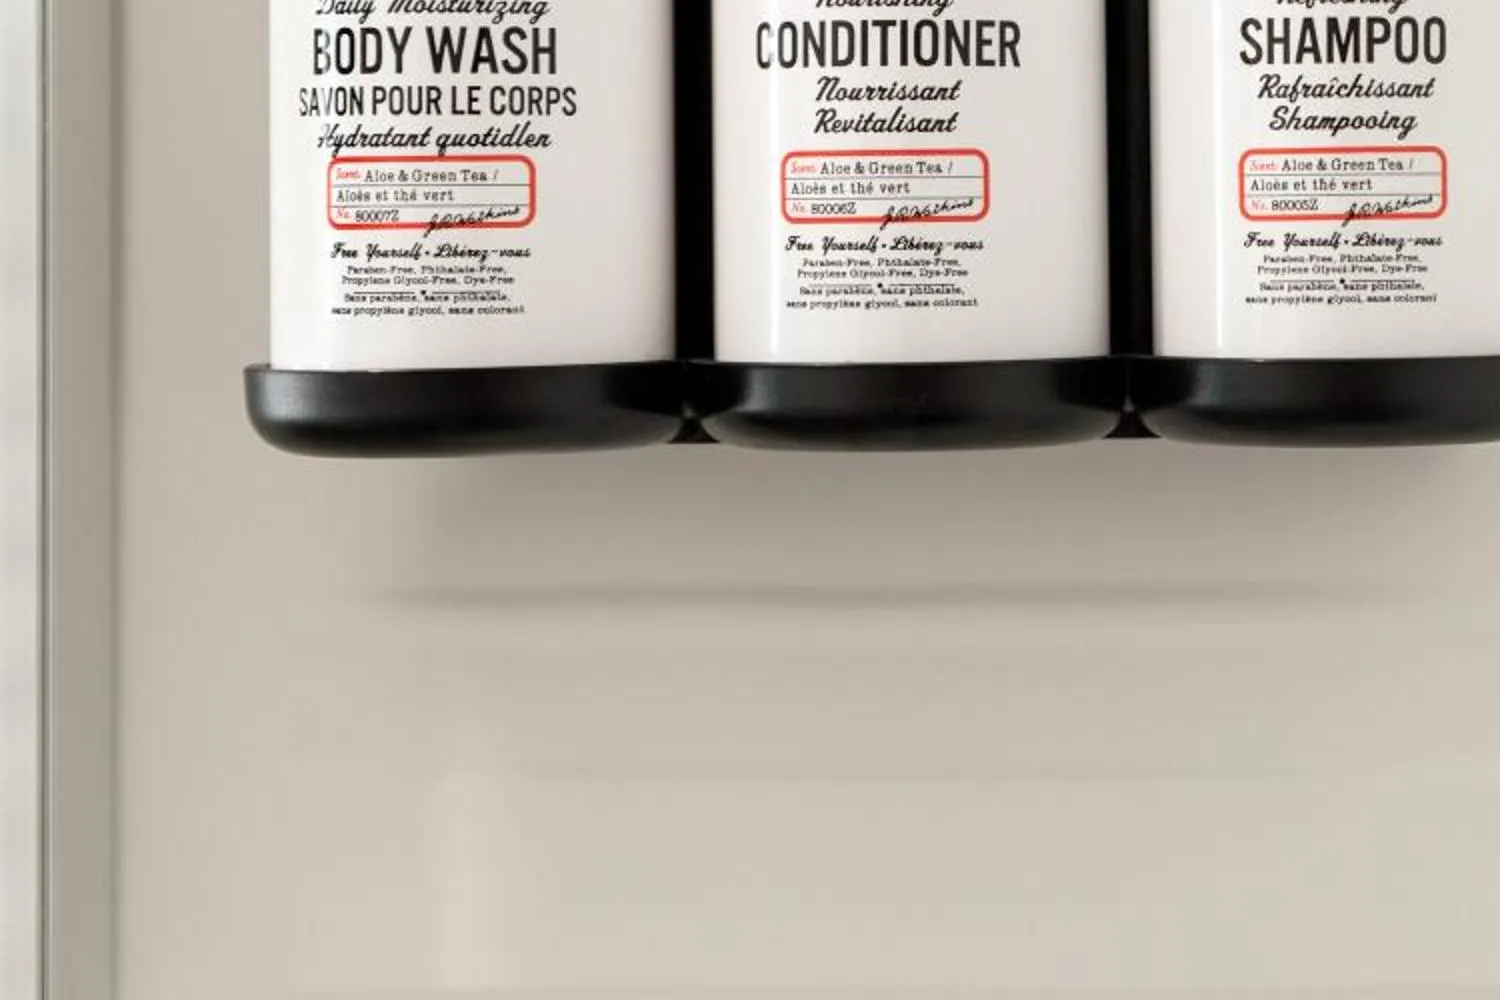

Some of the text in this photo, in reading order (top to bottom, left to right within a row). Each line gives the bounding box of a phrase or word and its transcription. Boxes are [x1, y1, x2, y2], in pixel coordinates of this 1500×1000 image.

[313, 26, 557, 75] BODY WASH
[756, 19, 1021, 69] CONDITIONER
[1239, 15, 1447, 65] SHAMPOO
[815, 76, 962, 101] Nourrissant
[1257, 73, 1436, 103] Rafraîchissant
[299, 85, 577, 117] SAVON POUR LE CORPS
[814, 106, 960, 133] Revitalisant
[1268, 105, 1418, 140] Shampooing
[316, 123, 432, 158] Hydratant
[364, 169, 395, 183] Aloe
[398, 169, 409, 182] &
[411, 168, 457, 182] Green
[460, 168, 488, 182] Tea
[820, 162, 851, 174] Aloe
[854, 162, 866, 174] &
[868, 161, 913, 174] Green
[916, 161, 943, 173] Tea
[1281, 159, 1312, 172] Aloe
[1316, 159, 1327, 171] &
[1331, 158, 1375, 171] Green
[1378, 158, 1404, 170] Tea
[375, 190, 389, 202] et
[393, 187, 417, 202] thé
[423, 189, 455, 201] vert
[791, 181, 911, 195] Aloès et thé vert
[1250, 178, 1373, 192] Aloès et thé vert
[330, 242, 359, 259] Free
[366, 242, 423, 262] Yourself
[785, 235, 814, 251] Free
[821, 235, 879, 255] Yourself
[1244, 232, 1275, 248] Free
[1283, 231, 1341, 252] Yourself
